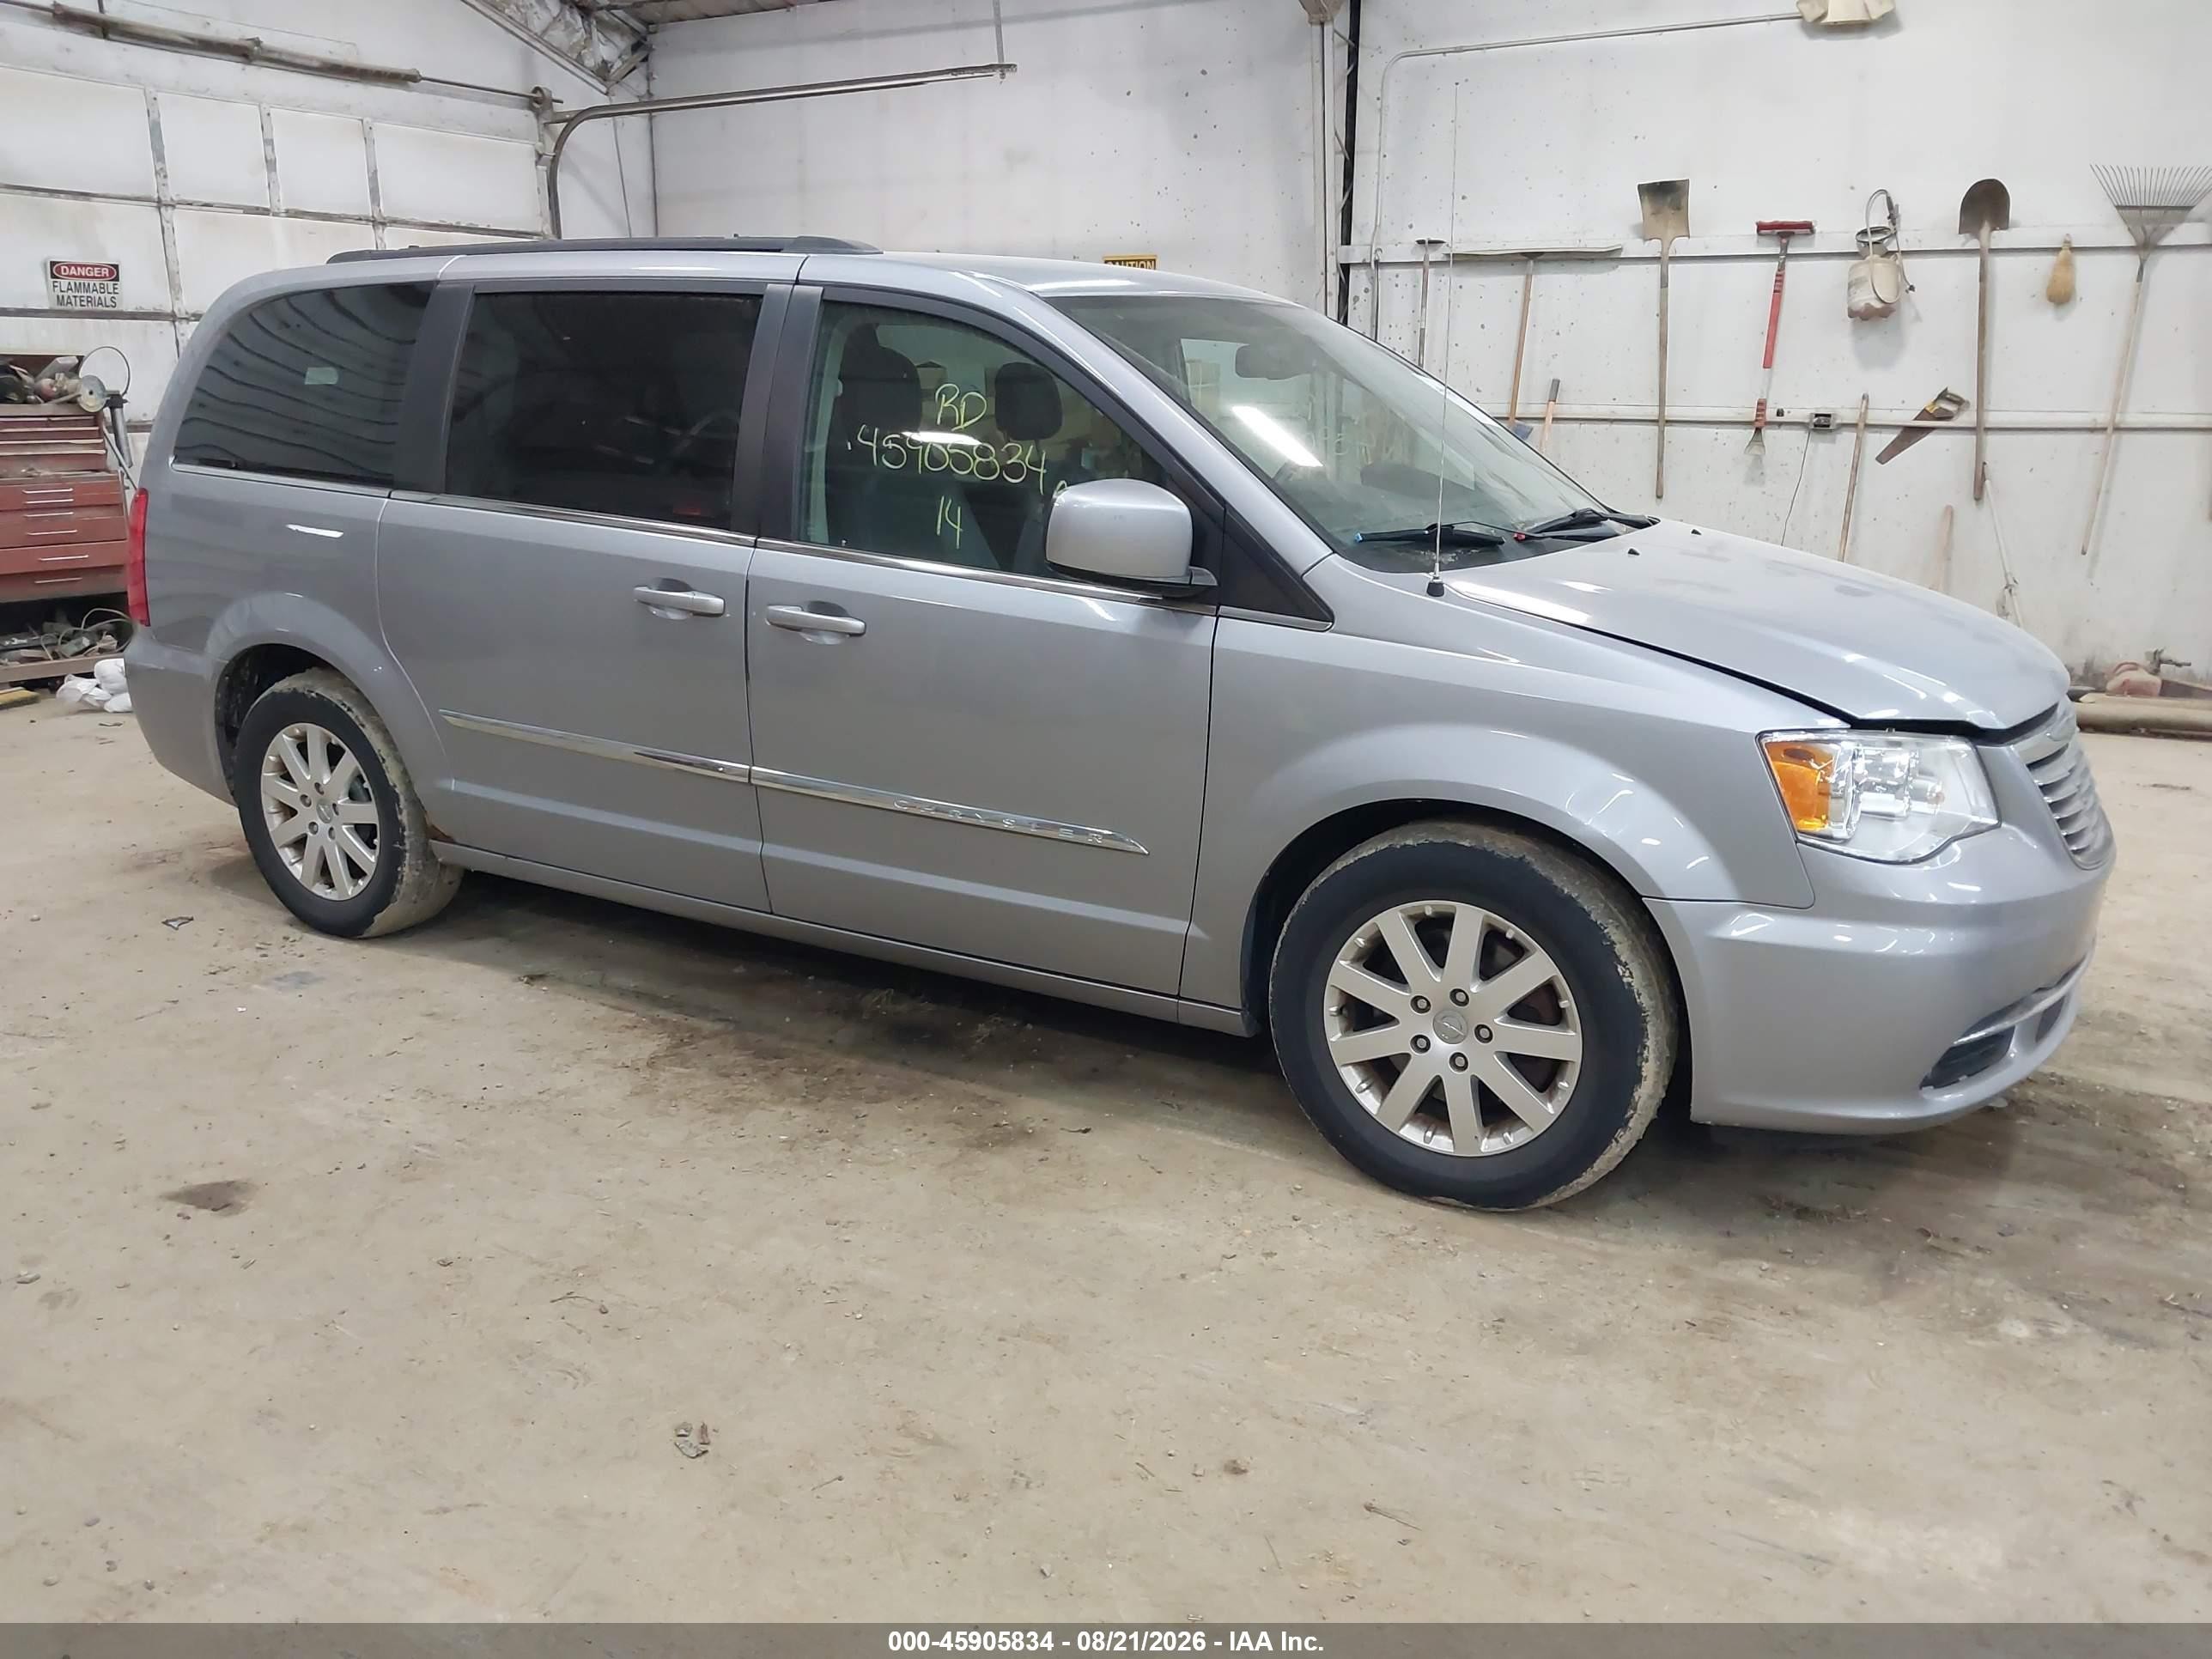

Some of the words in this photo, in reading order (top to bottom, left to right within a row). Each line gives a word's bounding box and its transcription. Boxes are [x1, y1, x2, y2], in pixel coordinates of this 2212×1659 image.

[60, 265, 109, 277] DANGER
[52, 280, 119, 295] FLAMMABLE
[57, 295, 117, 308] MATERIALS
[857, 424, 1047, 495] 45905834
[936, 495, 963, 550] 14
